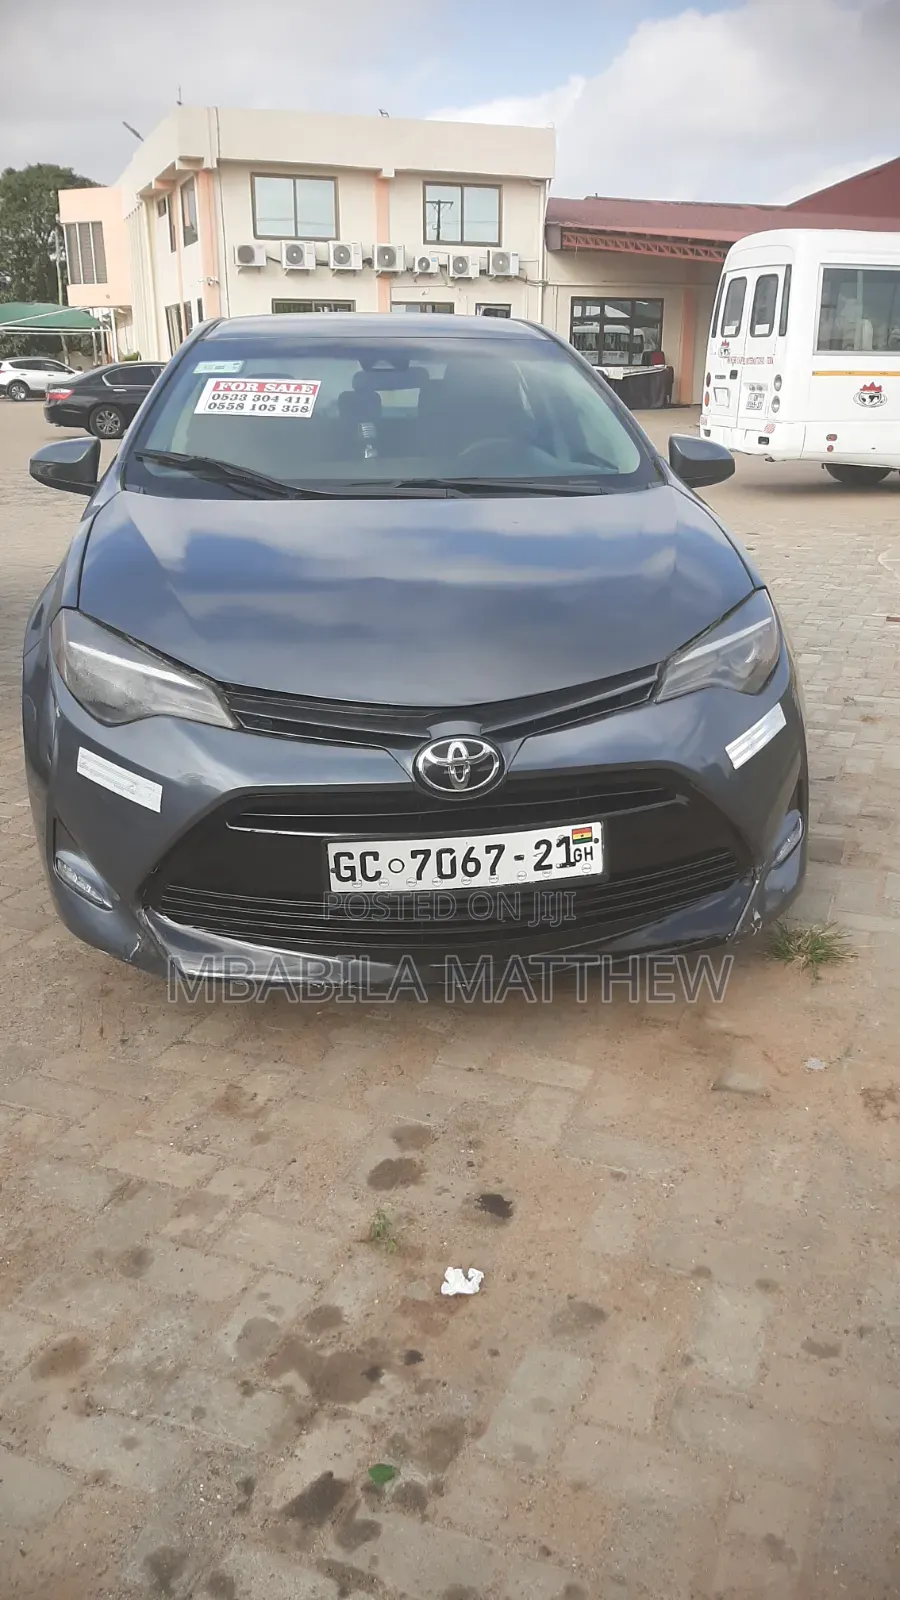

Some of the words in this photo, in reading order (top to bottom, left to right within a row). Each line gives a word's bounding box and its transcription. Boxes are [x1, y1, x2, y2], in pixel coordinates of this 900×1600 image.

[216, 382, 259, 392] FOR
[264, 383, 314, 394] SALE
[212, 393, 248, 401] 0533
[252, 394, 280, 403] 304
[284, 396, 311, 404] 411
[208, 402, 245, 411] 0558
[249, 403, 277, 412] 105
[281, 405, 309, 413] 358
[573, 846, 594, 863] GH
[334, 851, 382, 882] GC
